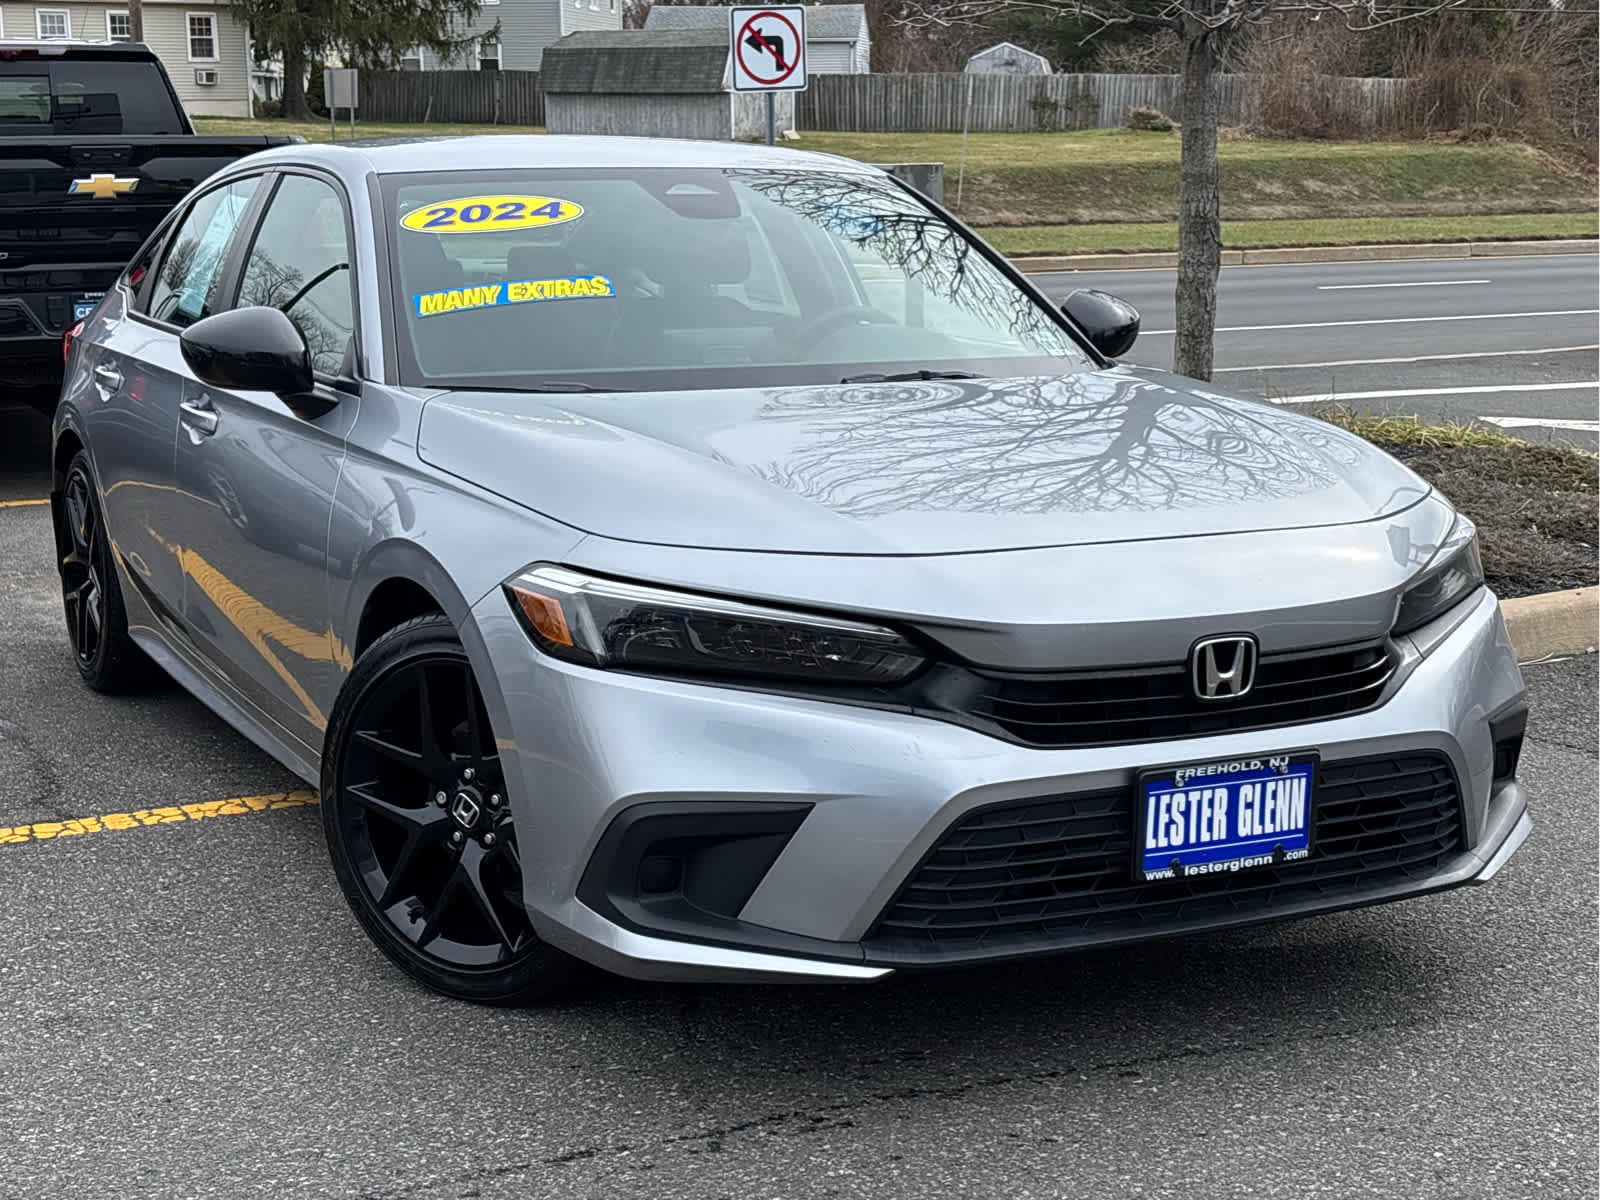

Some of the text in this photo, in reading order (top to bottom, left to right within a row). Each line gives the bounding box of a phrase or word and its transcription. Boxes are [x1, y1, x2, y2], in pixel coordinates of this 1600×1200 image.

[422, 202, 567, 228] 2024
[419, 276, 611, 315] MANY EXTRAS
[1269, 757, 1289, 768] NJ
[1145, 778, 1307, 849] LESTER GLENN
[1184, 855, 1273, 876] lesterglenn
